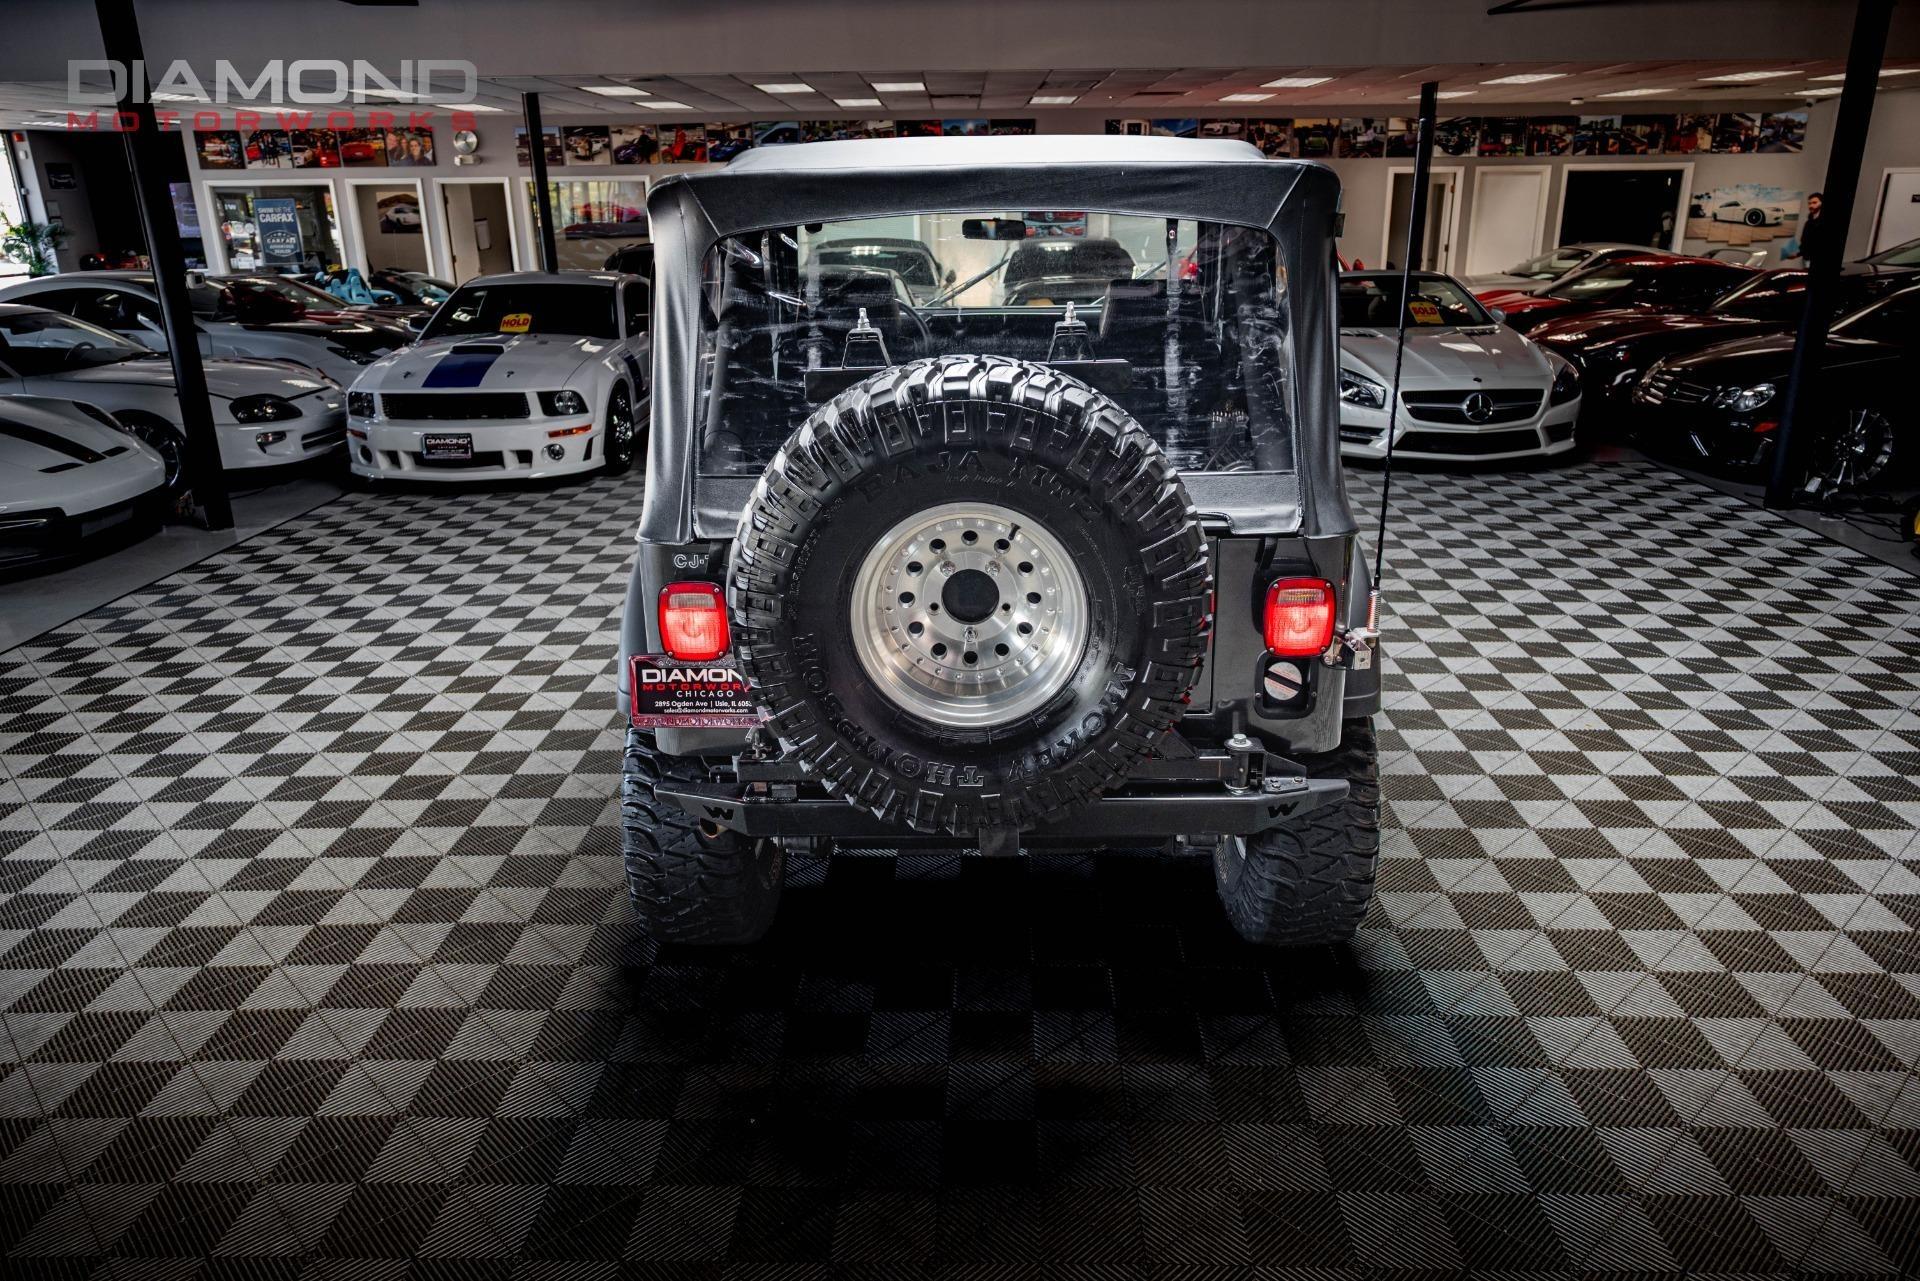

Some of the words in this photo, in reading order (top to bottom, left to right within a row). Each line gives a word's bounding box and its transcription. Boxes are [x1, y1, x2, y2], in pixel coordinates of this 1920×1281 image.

[260, 213, 294, 222] CARFAX
[642, 668, 743, 683] DIAMON
[642, 683, 741, 691] MOTORWOR
[676, 690, 734, 698] CHICAGO
[791, 633, 985, 787] THOMPSON
